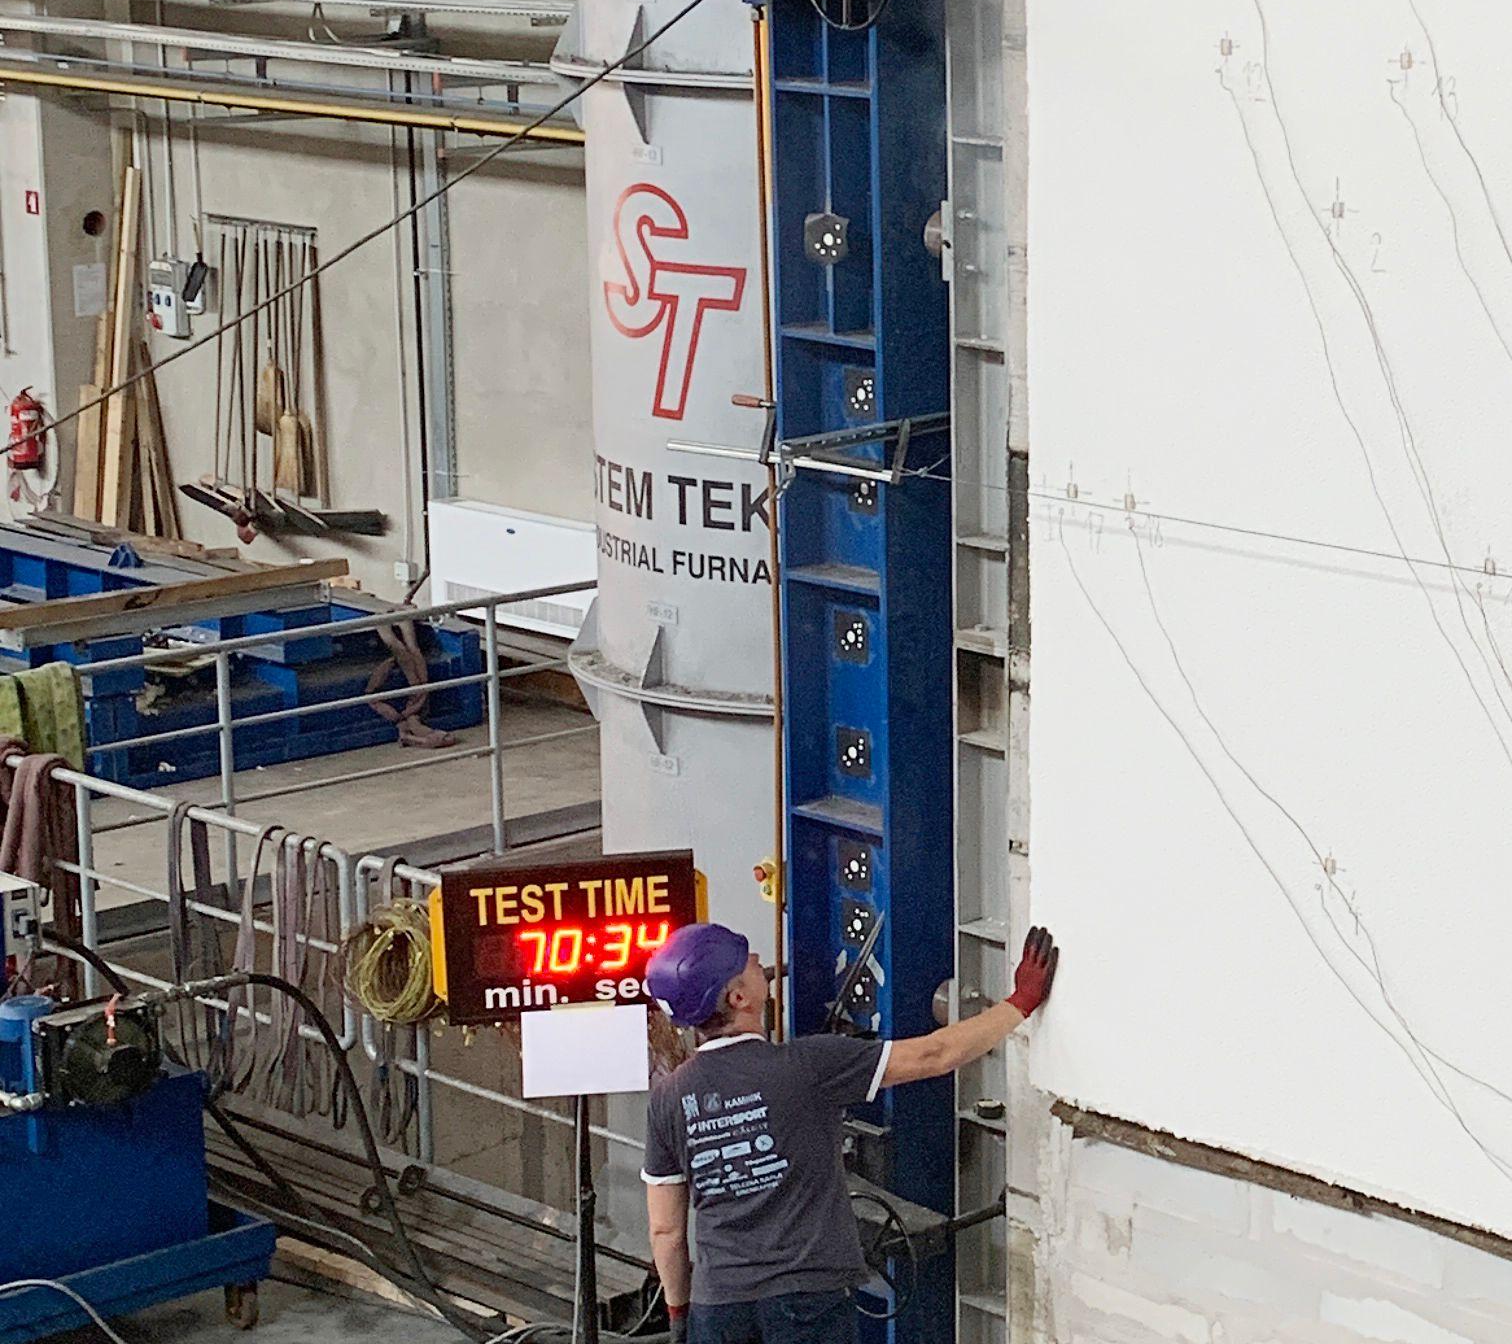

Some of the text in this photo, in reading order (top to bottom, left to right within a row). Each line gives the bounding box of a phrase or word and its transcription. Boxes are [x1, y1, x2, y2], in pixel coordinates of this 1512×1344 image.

[1369, 231, 1388, 274] 2
[603, 182, 748, 421] ST
[469, 874, 671, 926] TEST TIME
[517, 919, 671, 975] 70:34
[484, 978, 569, 1009] min.
[698, 1106, 768, 1133] INTERSPORT
